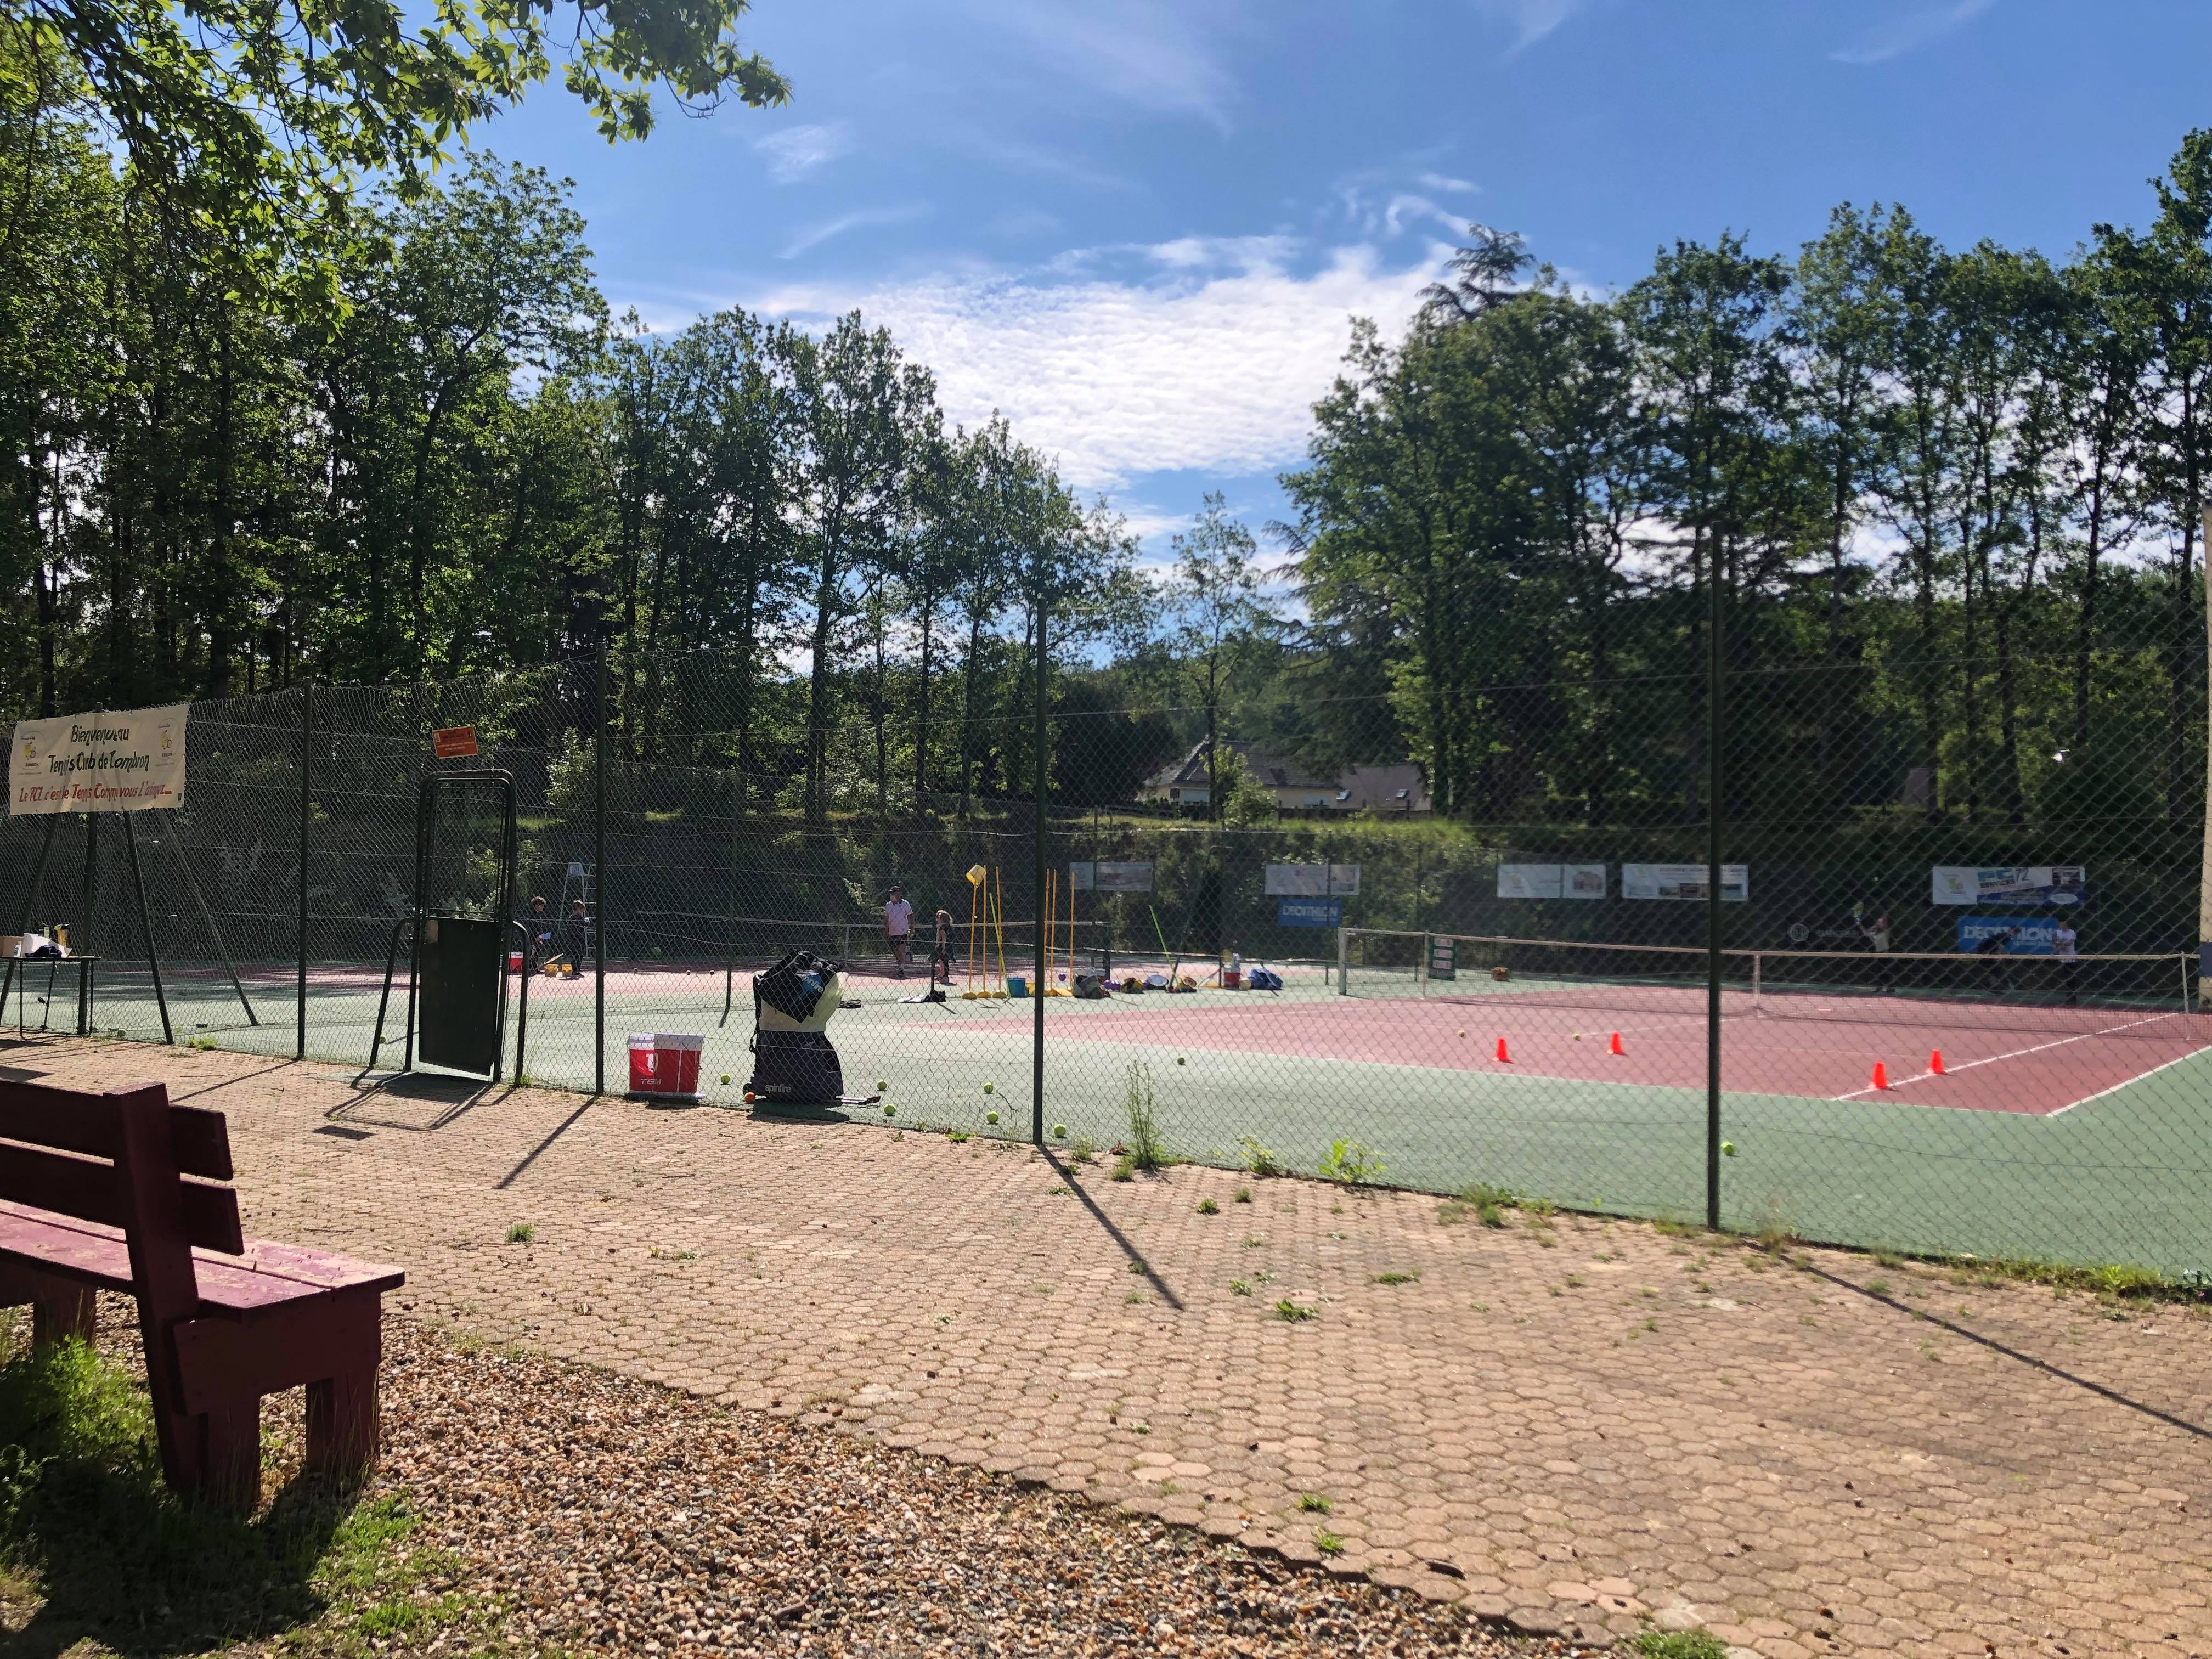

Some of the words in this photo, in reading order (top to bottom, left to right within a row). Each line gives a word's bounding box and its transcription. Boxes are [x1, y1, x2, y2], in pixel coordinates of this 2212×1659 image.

[48, 754, 75, 776] Tennis
[76, 752, 95, 771] Club
[98, 752, 108, 770] de
[110, 750, 150, 774] Lombron
[19, 787, 29, 802] Le
[30, 786, 43, 802] TCL
[765, 1083, 792, 1093] spinfire
